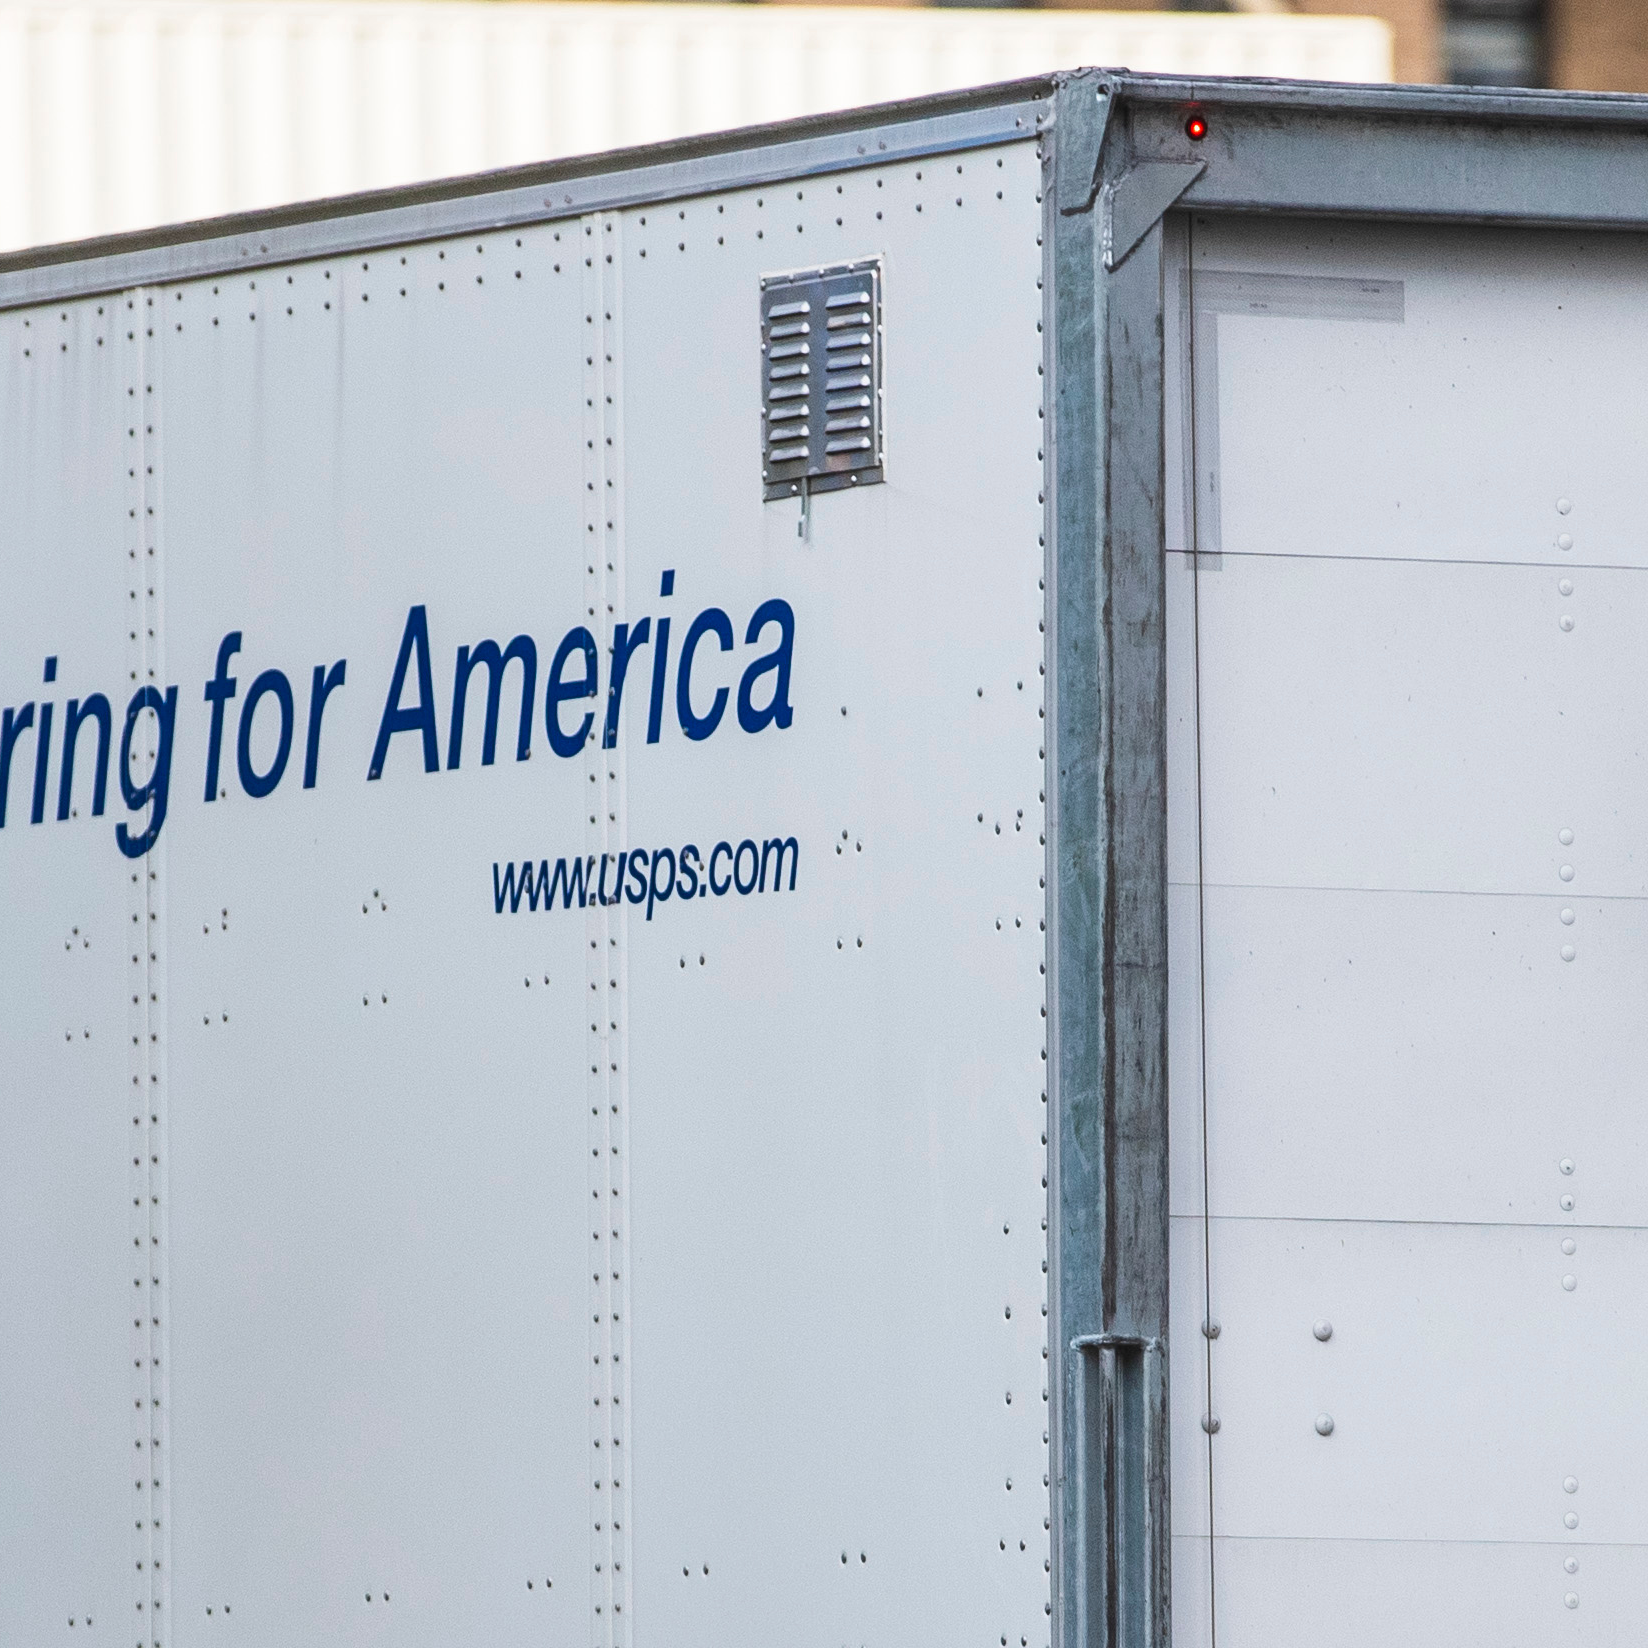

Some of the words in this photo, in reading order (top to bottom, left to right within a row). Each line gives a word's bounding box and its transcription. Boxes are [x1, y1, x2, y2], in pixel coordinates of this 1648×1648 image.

[204, 631, 348, 803] for
[366, 569, 796, 782] America
[492, 836, 799, 922] www.usps.com
